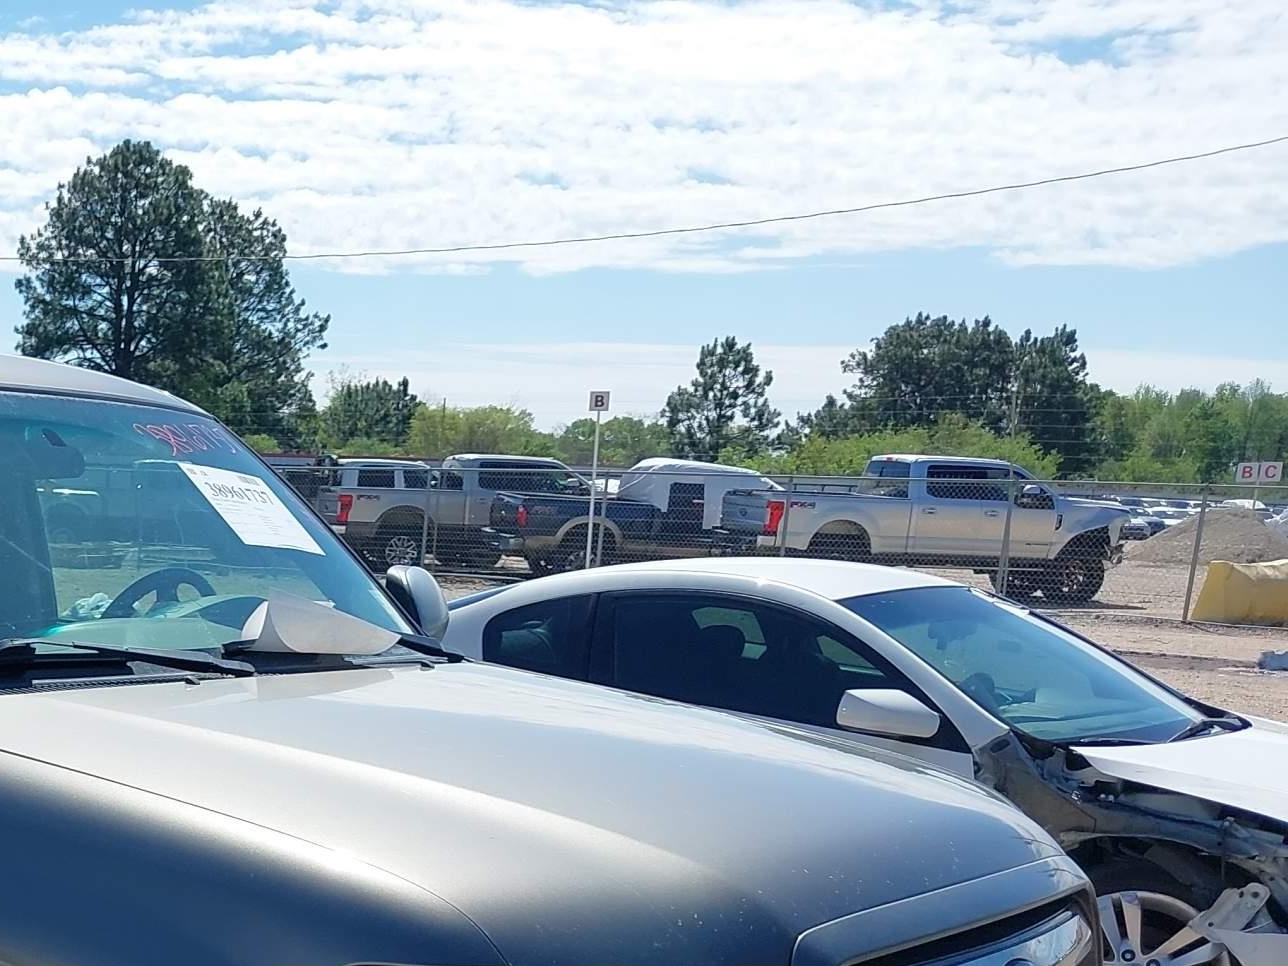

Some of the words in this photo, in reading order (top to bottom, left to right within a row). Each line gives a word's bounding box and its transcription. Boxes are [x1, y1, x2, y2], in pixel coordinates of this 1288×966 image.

[594, 394, 605, 408] B
[1241, 465, 1253, 479] B
[1264, 464, 1278, 479] C
[204, 481, 274, 505] 38961737
